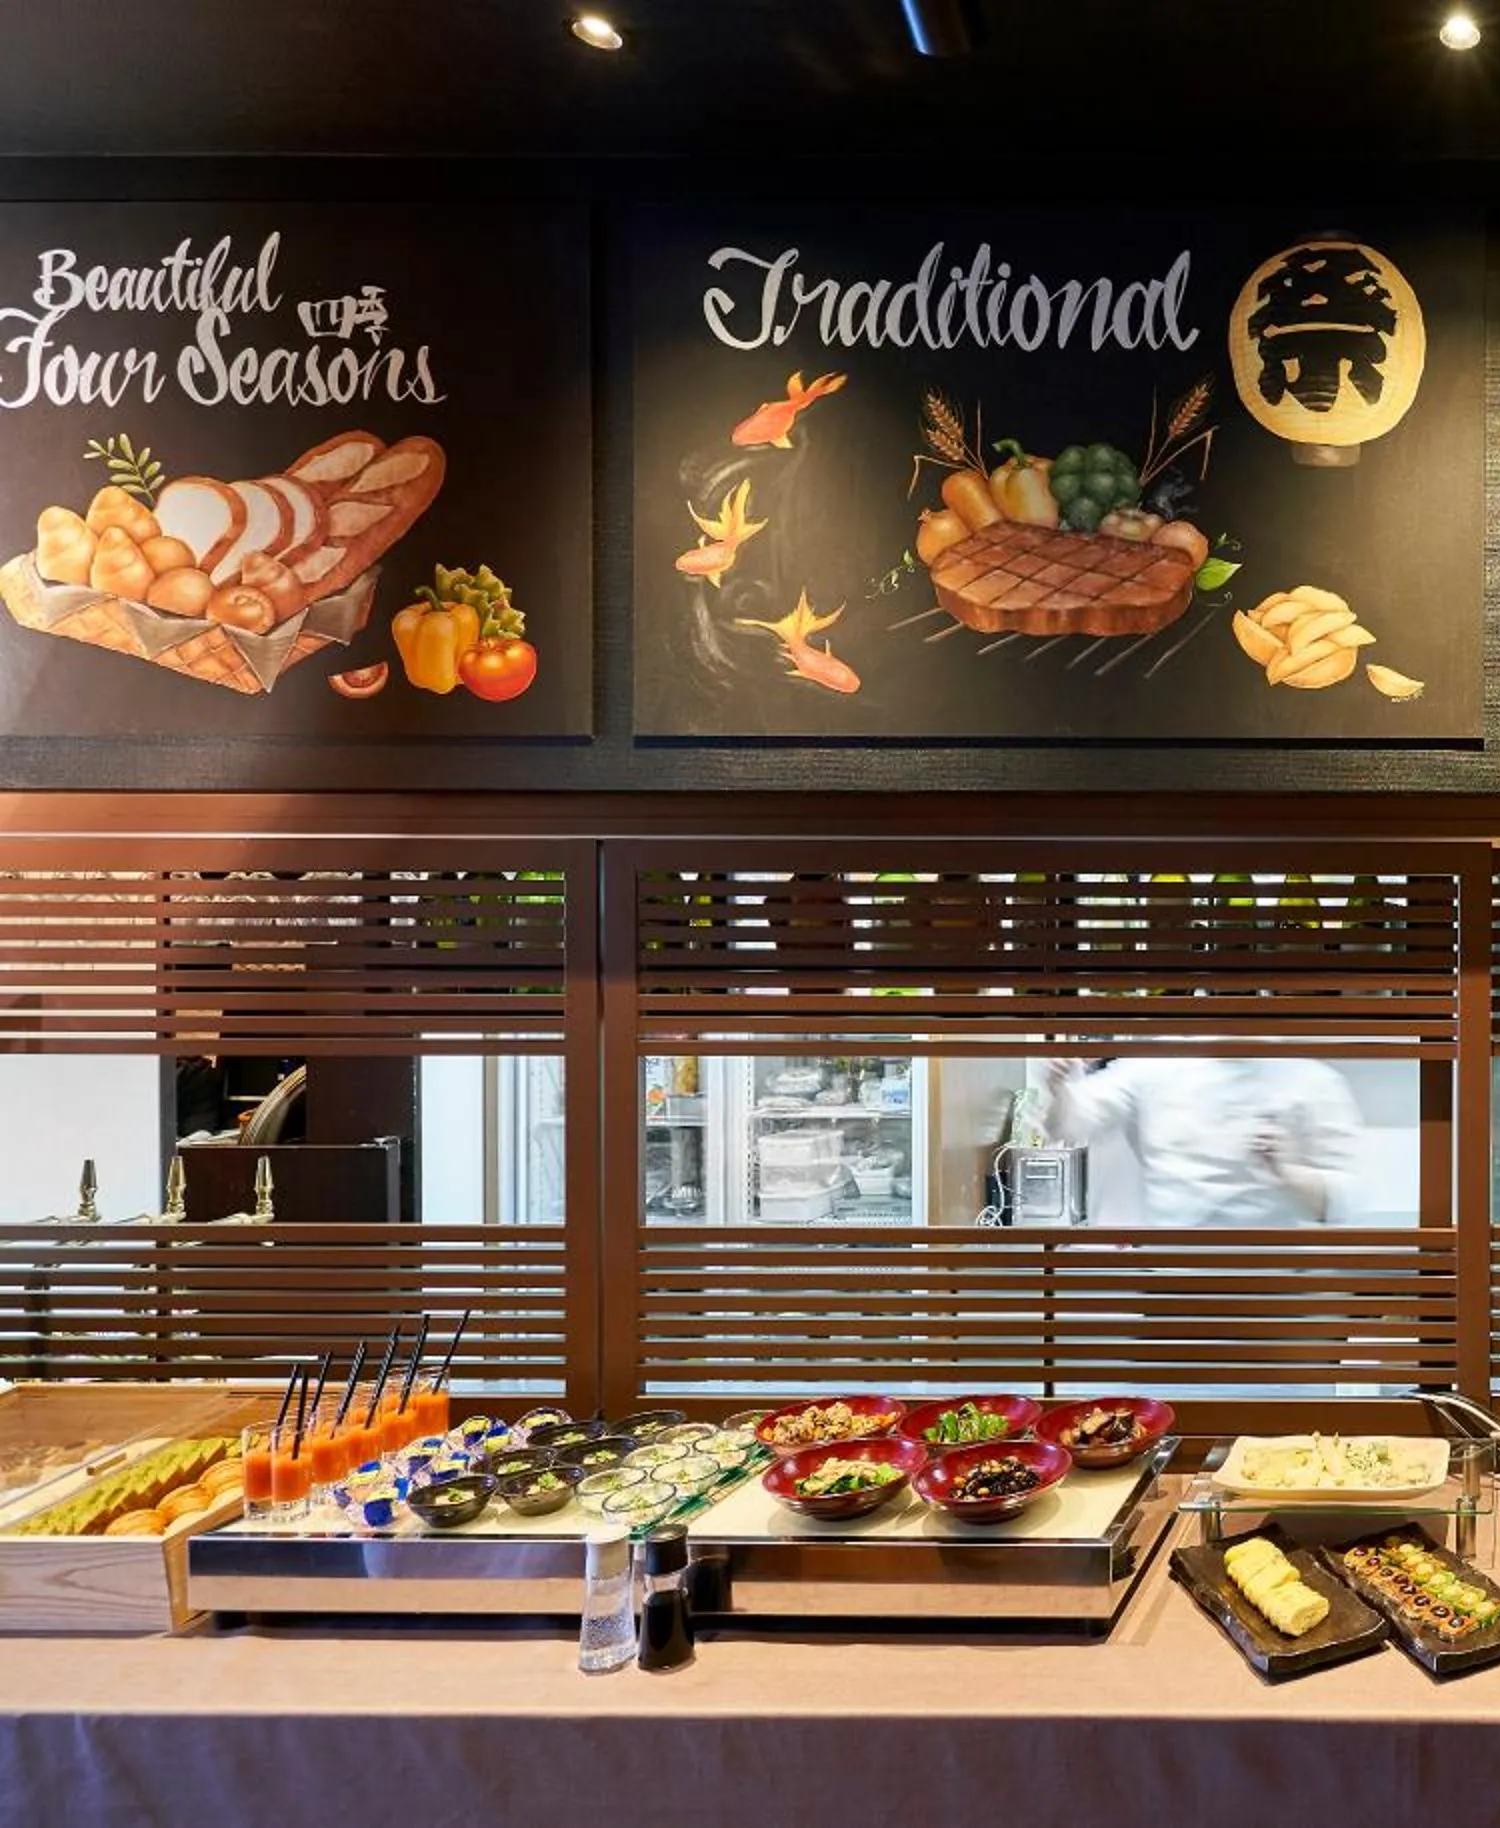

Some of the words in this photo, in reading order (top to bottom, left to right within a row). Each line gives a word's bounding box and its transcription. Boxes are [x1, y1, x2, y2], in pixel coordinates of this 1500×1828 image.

[32, 230, 284, 313] Beautiful
[297, 285, 391, 344] 四季
[702, 240, 1200, 352] Traditional
[0, 305, 168, 409] Four
[176, 306, 448, 406] Seasons
